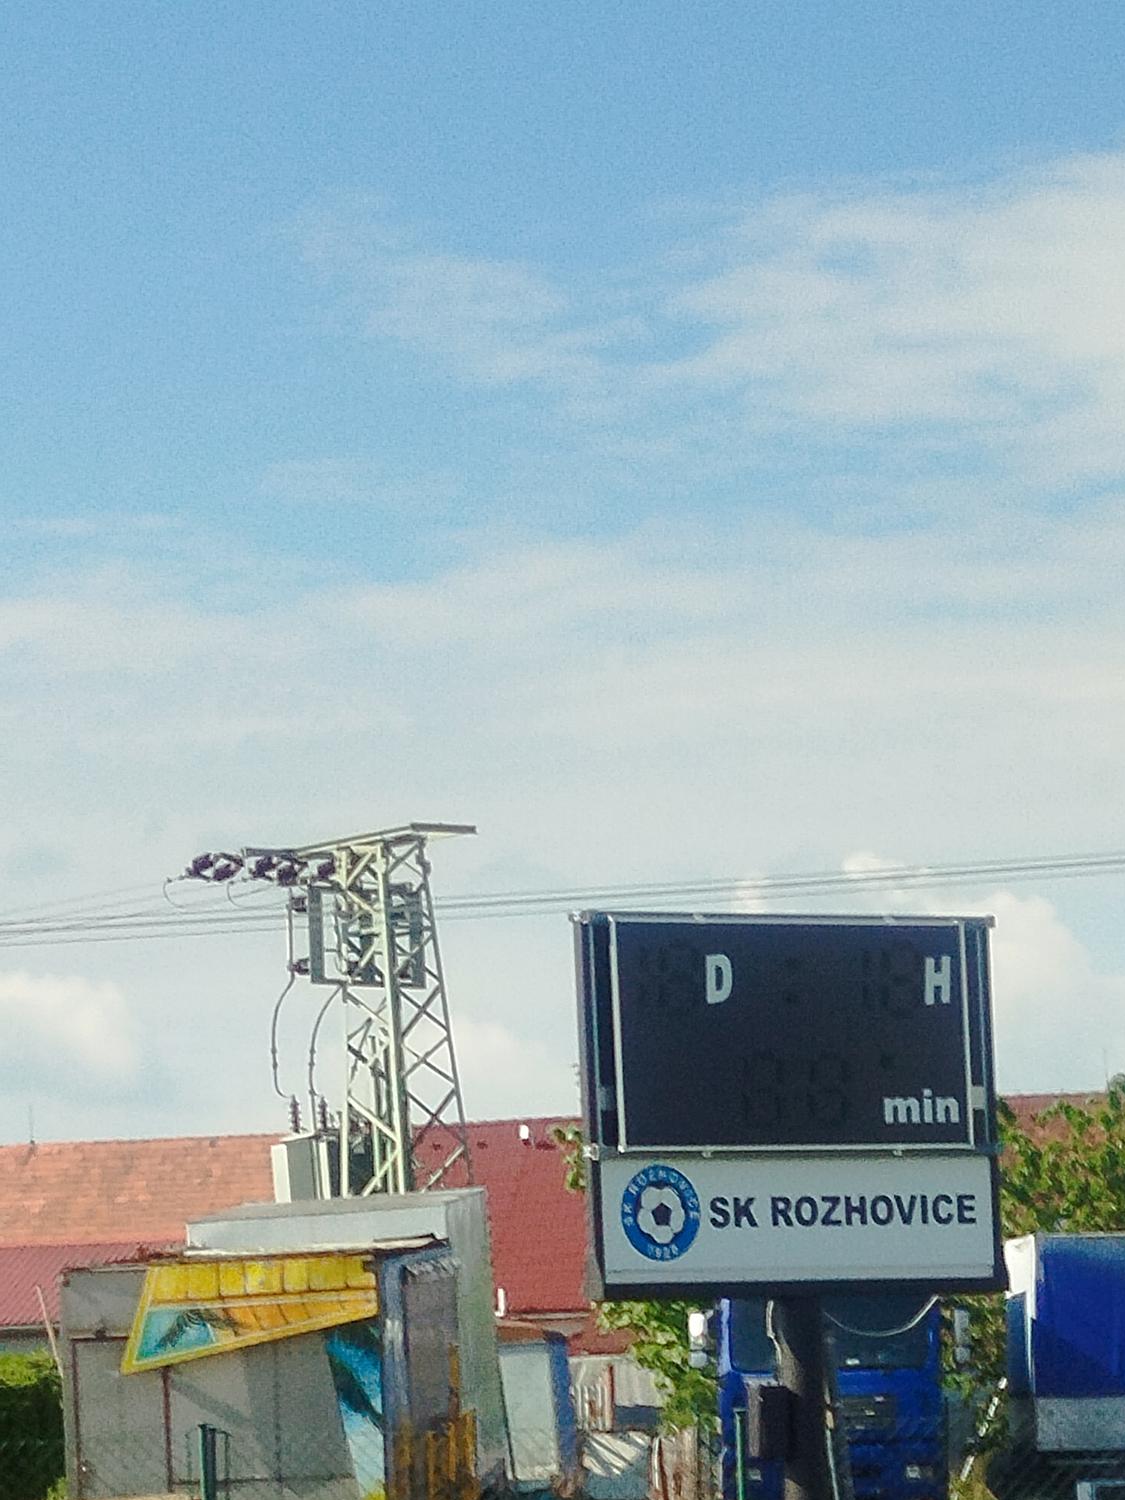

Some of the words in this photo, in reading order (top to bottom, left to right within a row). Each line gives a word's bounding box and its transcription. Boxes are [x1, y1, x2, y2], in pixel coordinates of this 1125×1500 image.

[705, 954, 733, 1004] D
[924, 955, 951, 1005] H
[883, 1089, 959, 1125] min
[709, 1196, 758, 1228] SK
[771, 1194, 977, 1227] ROZHOVICE
